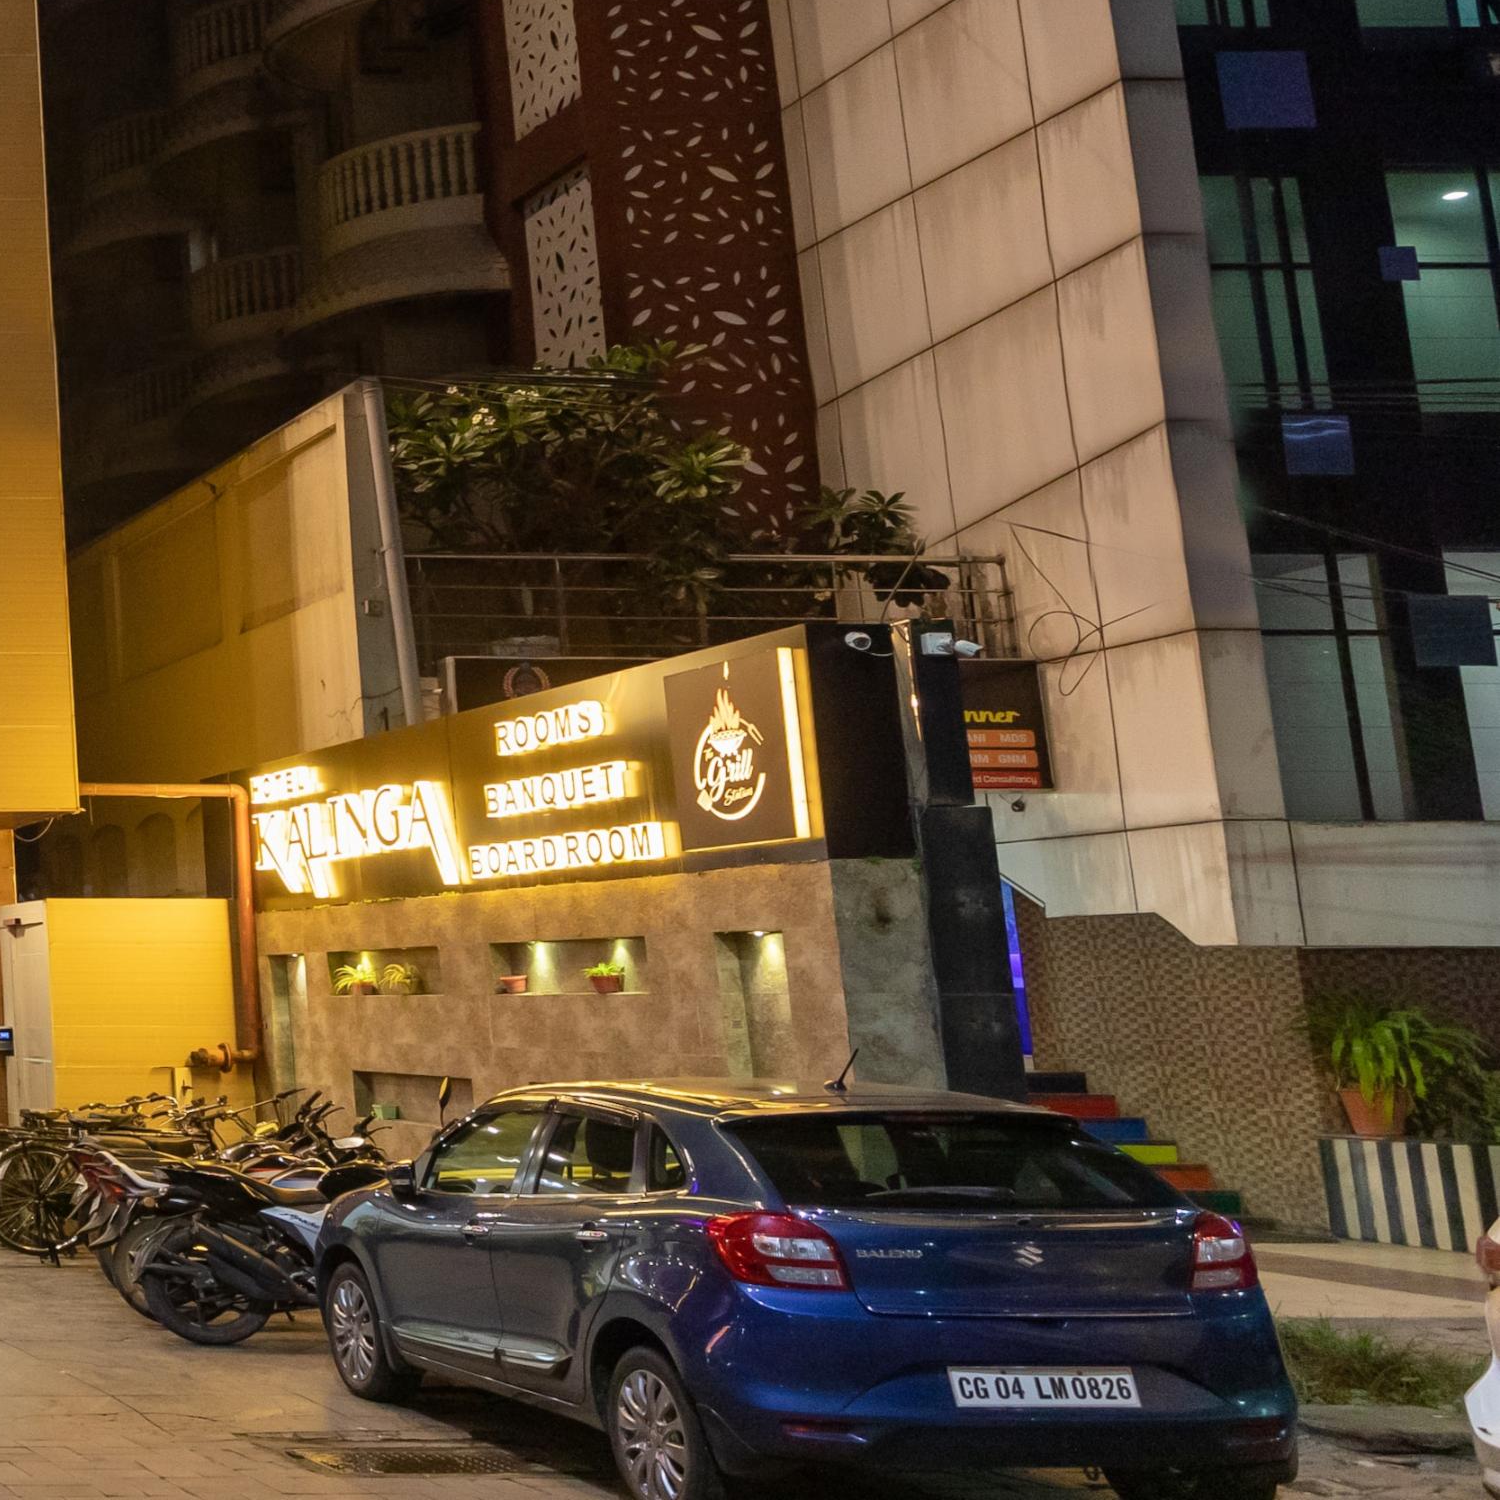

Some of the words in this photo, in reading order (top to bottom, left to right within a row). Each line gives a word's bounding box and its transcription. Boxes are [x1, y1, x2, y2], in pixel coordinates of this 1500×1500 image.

[495, 703, 598, 756] ROOMS
[485, 763, 619, 817] BANQUET
[252, 781, 460, 898] KALINGA
[855, 1249, 923, 1259] BALENO
[958, 1376, 990, 1400] CG
[994, 1376, 1025, 1400] 04
